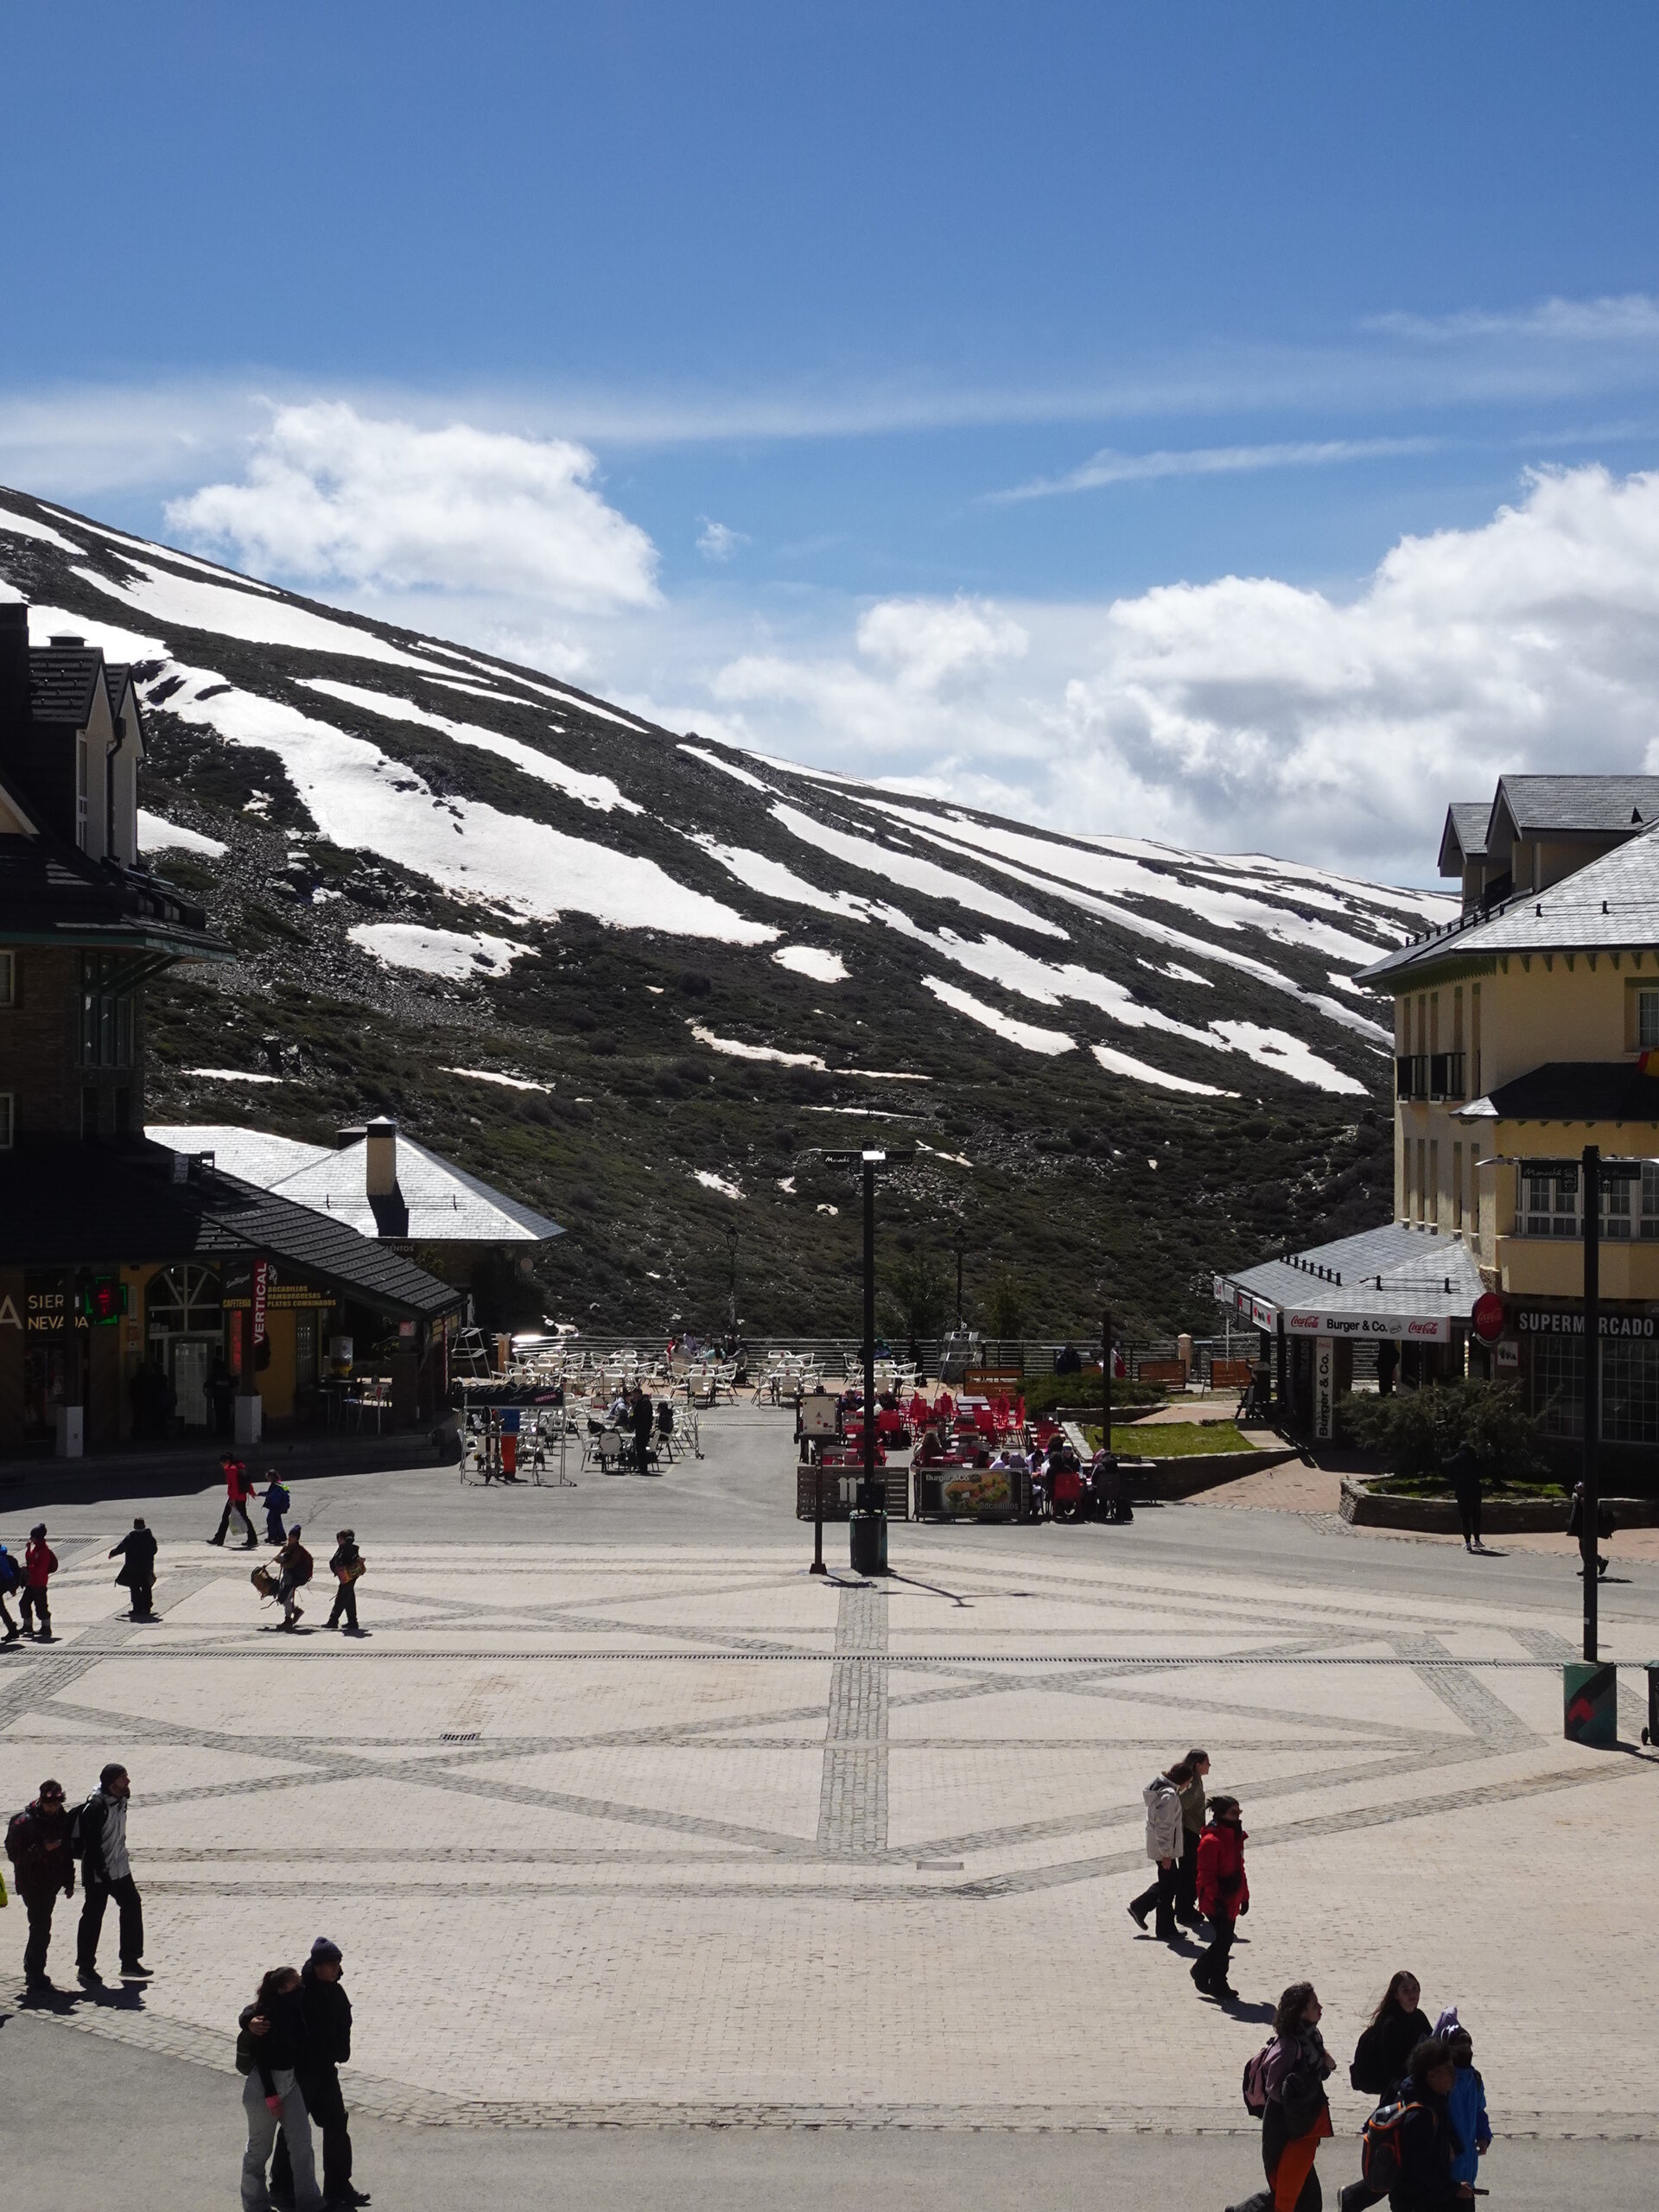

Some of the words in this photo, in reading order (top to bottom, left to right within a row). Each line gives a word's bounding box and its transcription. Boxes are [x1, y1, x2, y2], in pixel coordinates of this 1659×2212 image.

[28, 1294, 65, 1309] SIER
[254, 1262, 267, 1344] VERTICAL
[1327, 1319, 1360, 1332] Burger
[1362, 1320, 1370, 1330] &
[1371, 1321, 1388, 1332] Co.
[1519, 1313, 1654, 1337] SUPERMRCADO
[1319, 1354, 1329, 1374] Co.
[1319, 1378, 1328, 1388] &
[1319, 1391, 1331, 1437] Burger
